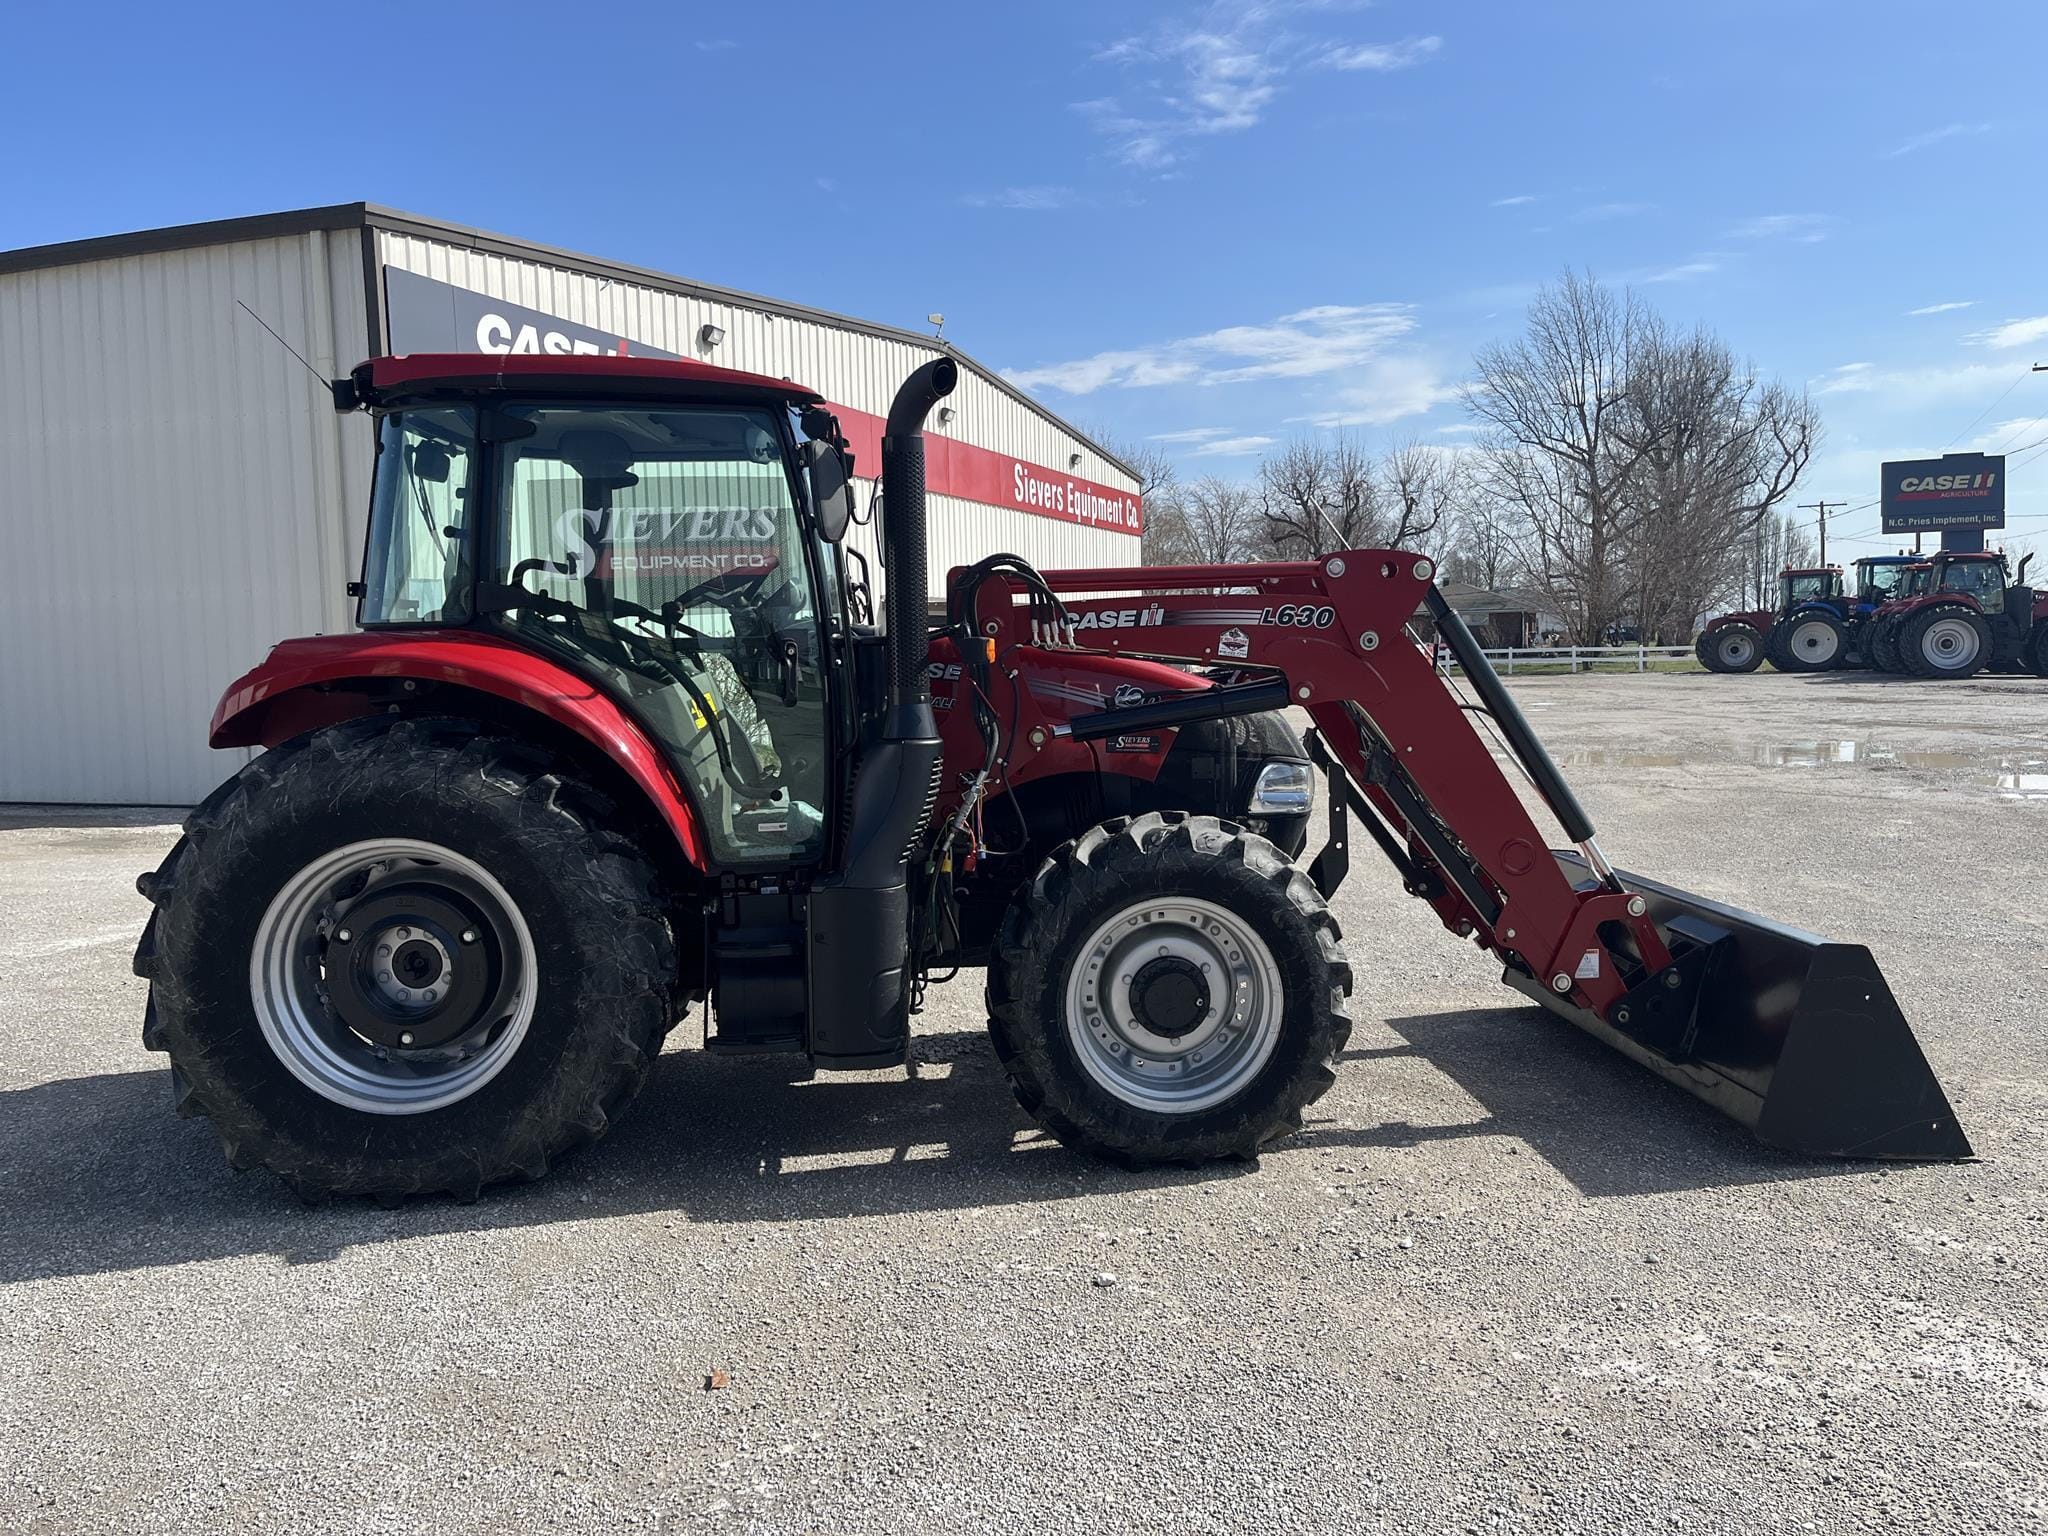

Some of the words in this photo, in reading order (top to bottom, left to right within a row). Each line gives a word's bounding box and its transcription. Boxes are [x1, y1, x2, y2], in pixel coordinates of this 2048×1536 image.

[1900, 475, 1971, 492] CASE
[1014, 462, 1063, 512] Sievers
[1067, 481, 1122, 525] Equipment
[1126, 498, 1139, 529] Co.
[1940, 490, 1988, 498] AGRICULTURE
[1888, 518, 1906, 527] N.C.
[1908, 517, 1931, 526] Pries
[1932, 515, 1981, 526] Implement,
[1983, 514, 2000, 523] Inc.
[542, 505, 779, 580] SIEVERS
[610, 554, 729, 571] EQUIPMENT
[734, 553, 769, 568] CO.
[1259, 603, 1336, 630] L630
[1116, 736, 1151, 748] SIEVERS
